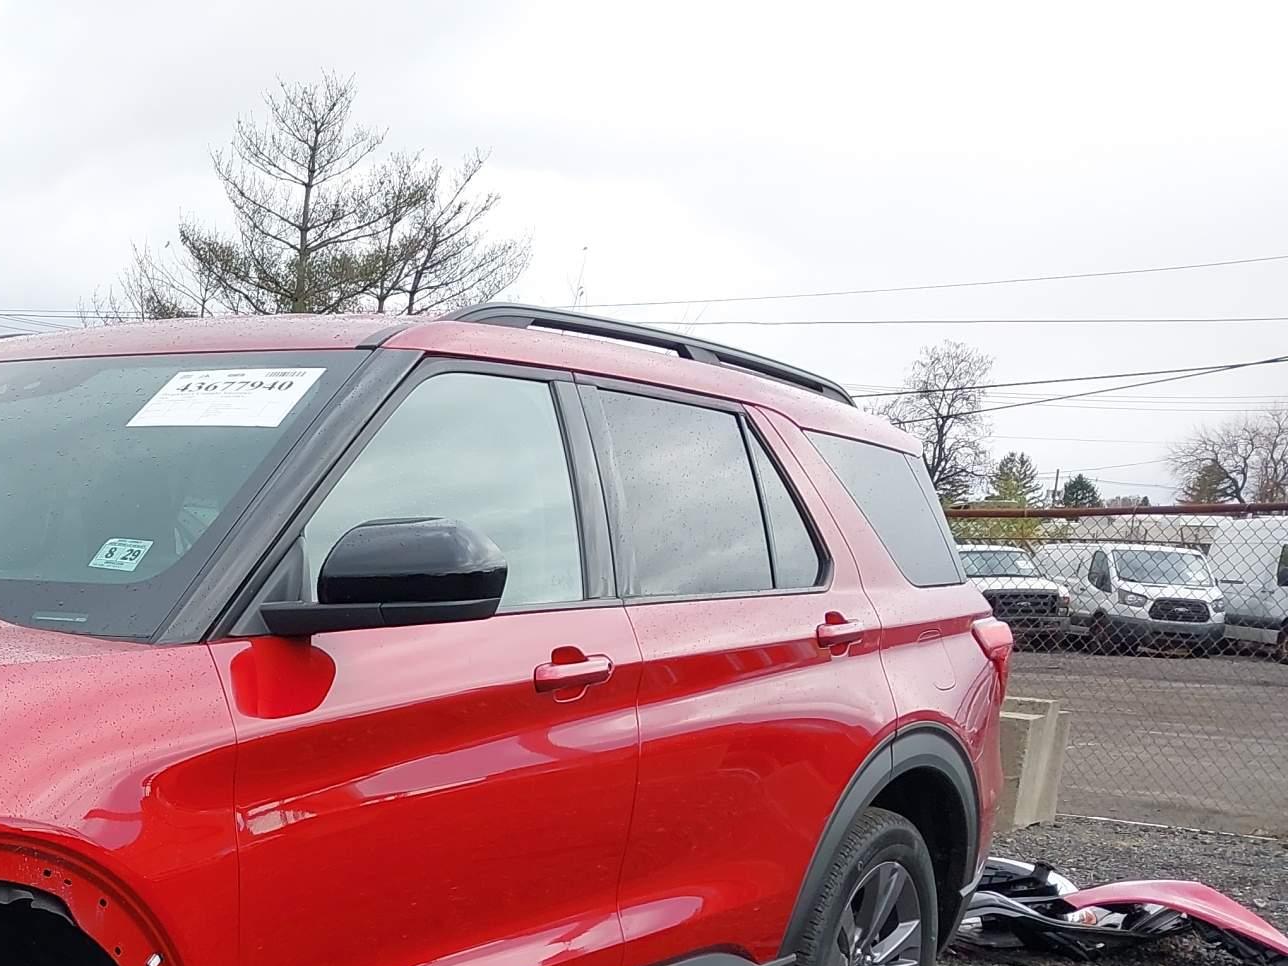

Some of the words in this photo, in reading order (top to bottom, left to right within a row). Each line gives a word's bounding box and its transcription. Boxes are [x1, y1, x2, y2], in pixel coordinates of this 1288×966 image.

[176, 380, 294, 392] 43677940
[104, 547, 117, 559] 8
[120, 548, 141, 561] 29
